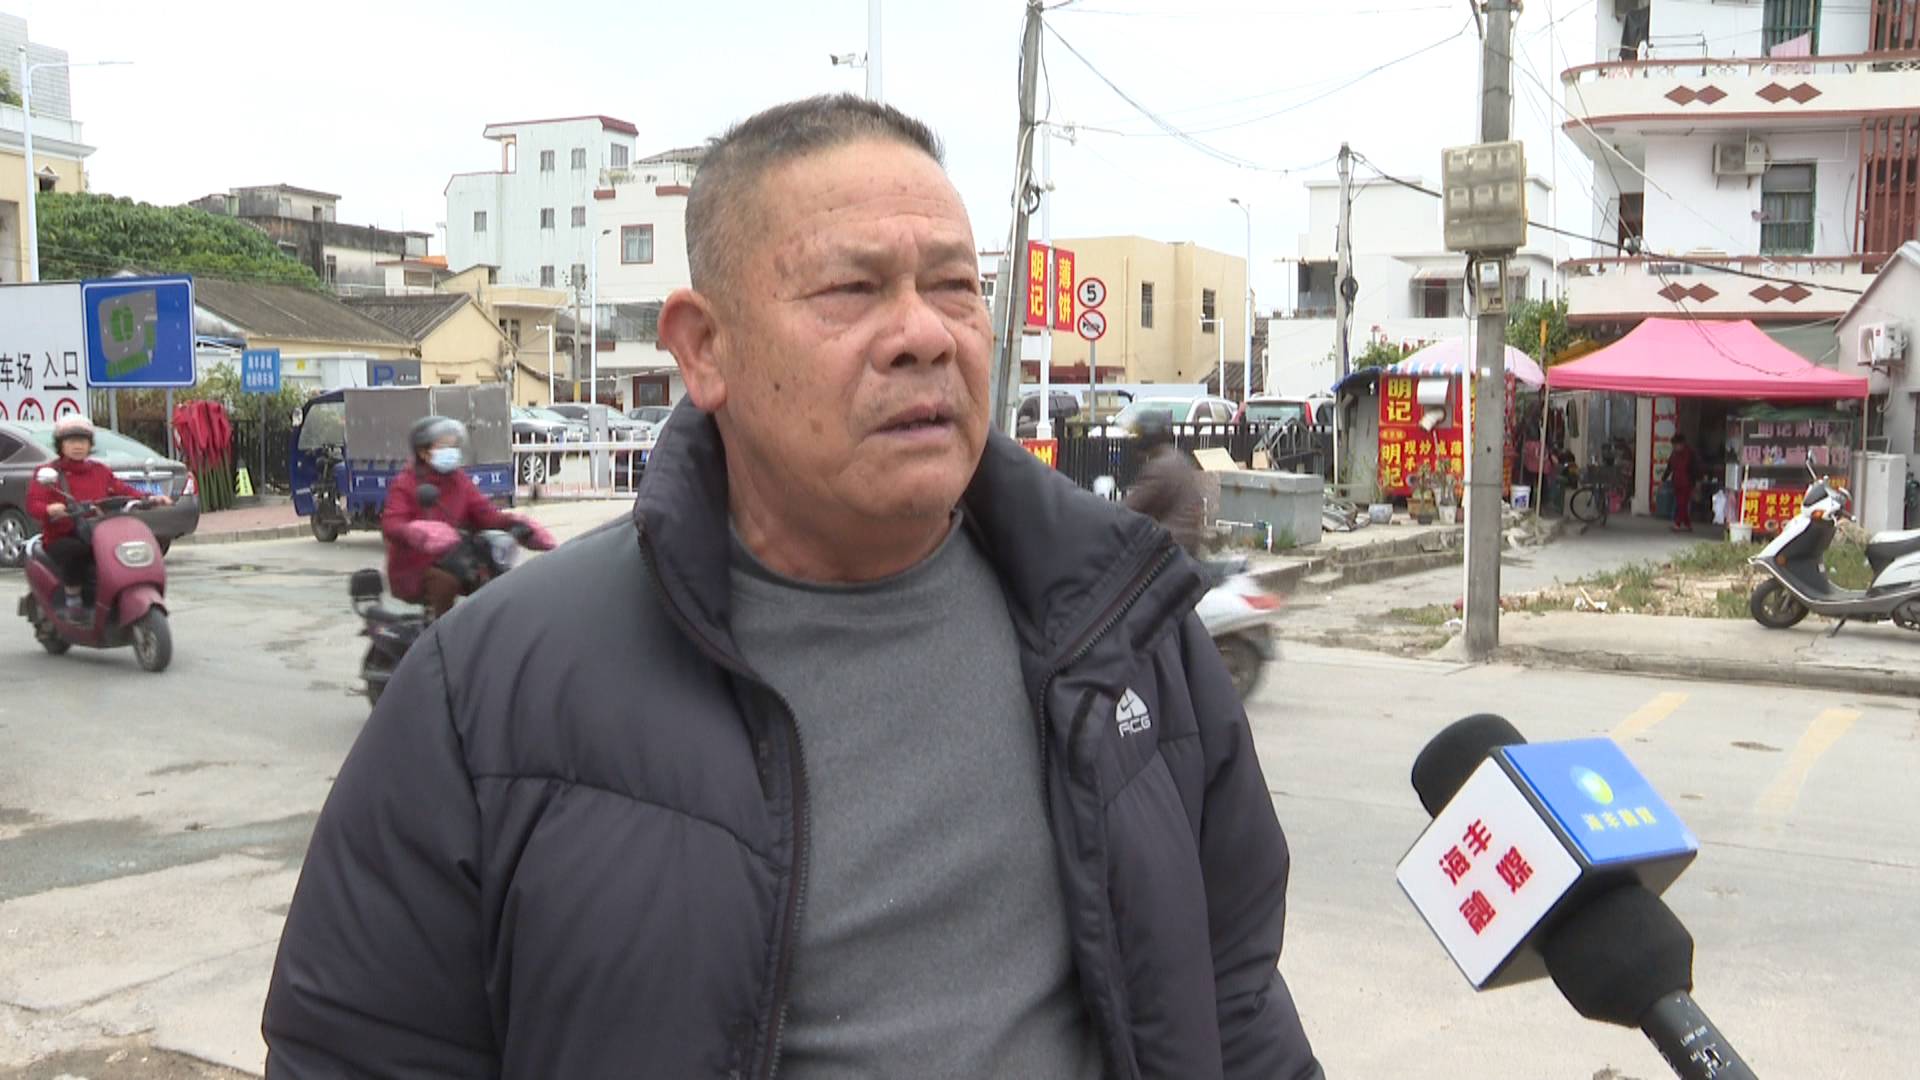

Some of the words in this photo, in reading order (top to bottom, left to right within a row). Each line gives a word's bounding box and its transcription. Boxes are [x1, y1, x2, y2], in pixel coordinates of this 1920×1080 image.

[1030, 250, 1044, 317] 明记
[1058, 257, 1071, 324] 薄饼
[1086, 284, 1097, 302] 5
[43, 351, 78, 378] 入口
[1387, 379, 1412, 421] 明记
[1382, 443, 1404, 487] 明记
[1119, 714, 1152, 738] ACG
